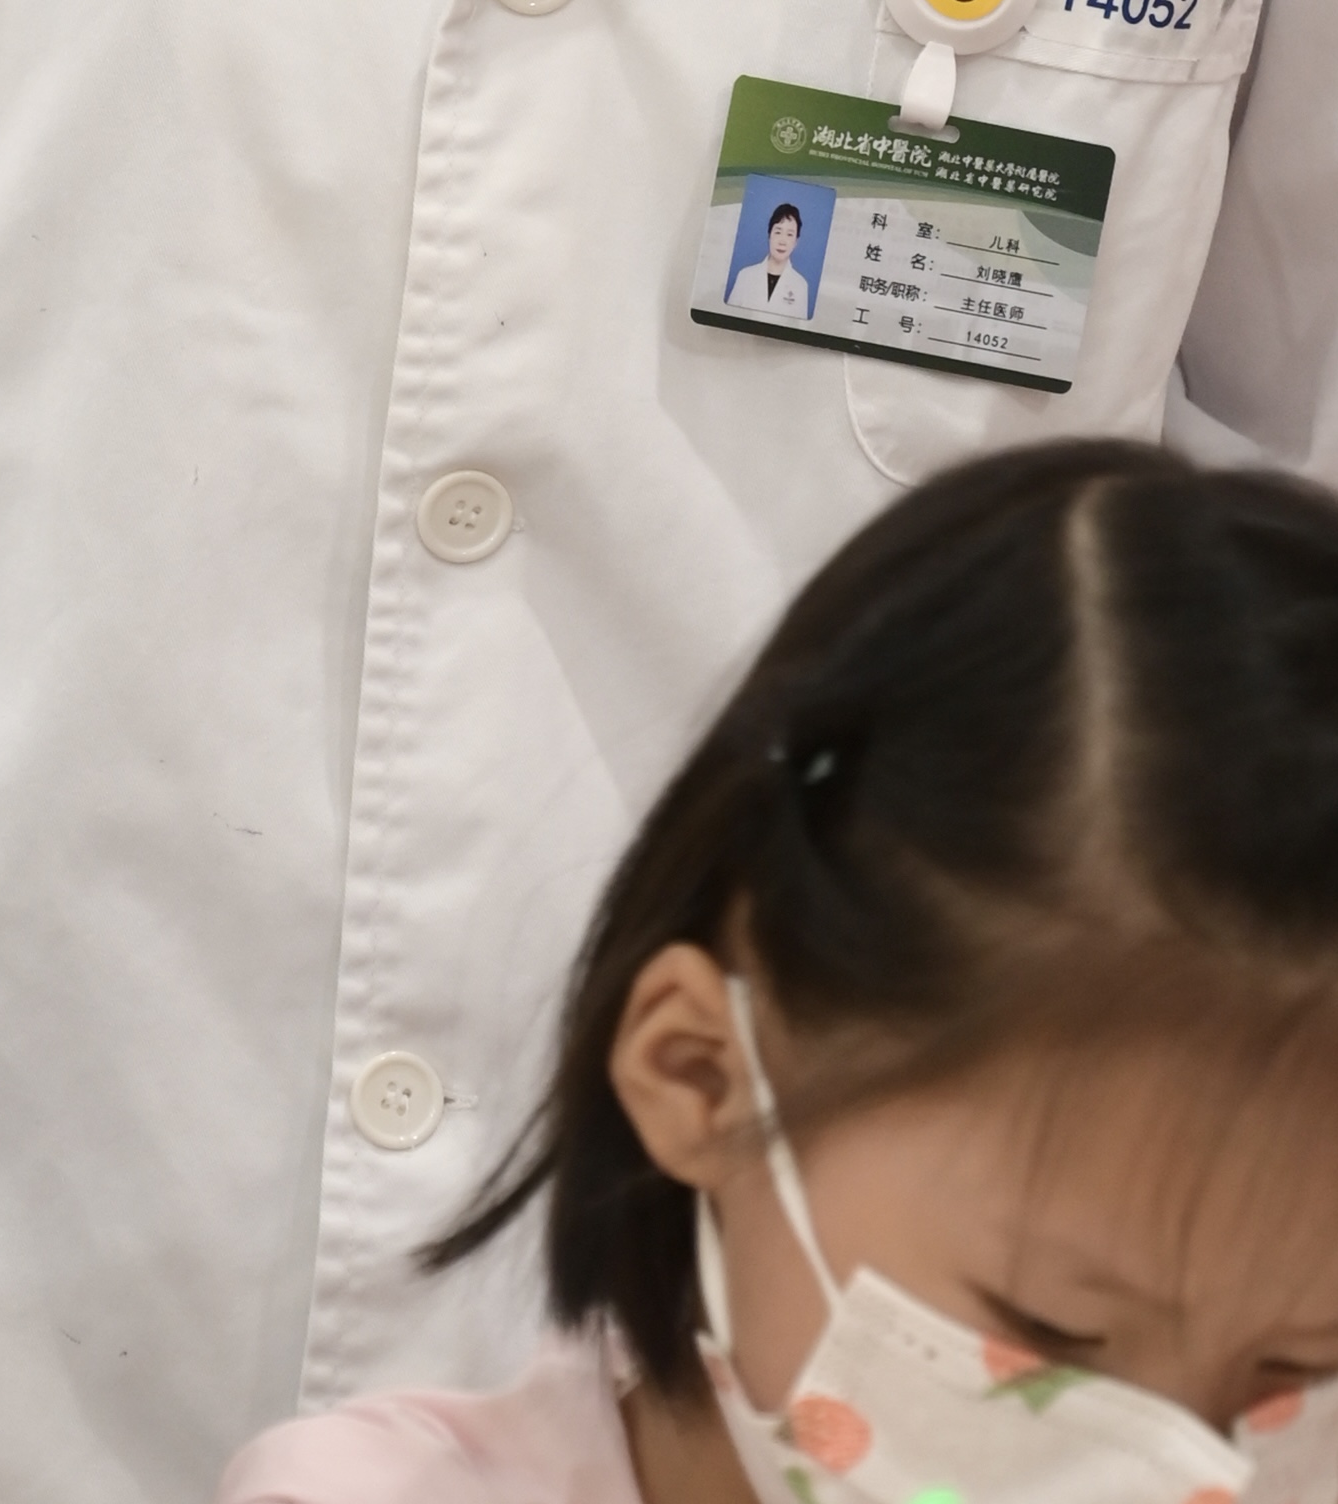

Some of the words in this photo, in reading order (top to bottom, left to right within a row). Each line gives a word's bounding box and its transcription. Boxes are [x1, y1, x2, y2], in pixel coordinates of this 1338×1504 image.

[989, 235, 1021, 254] 儿科
[961, 297, 1025, 321] 主任医师
[966, 331, 1009, 350] 14052
